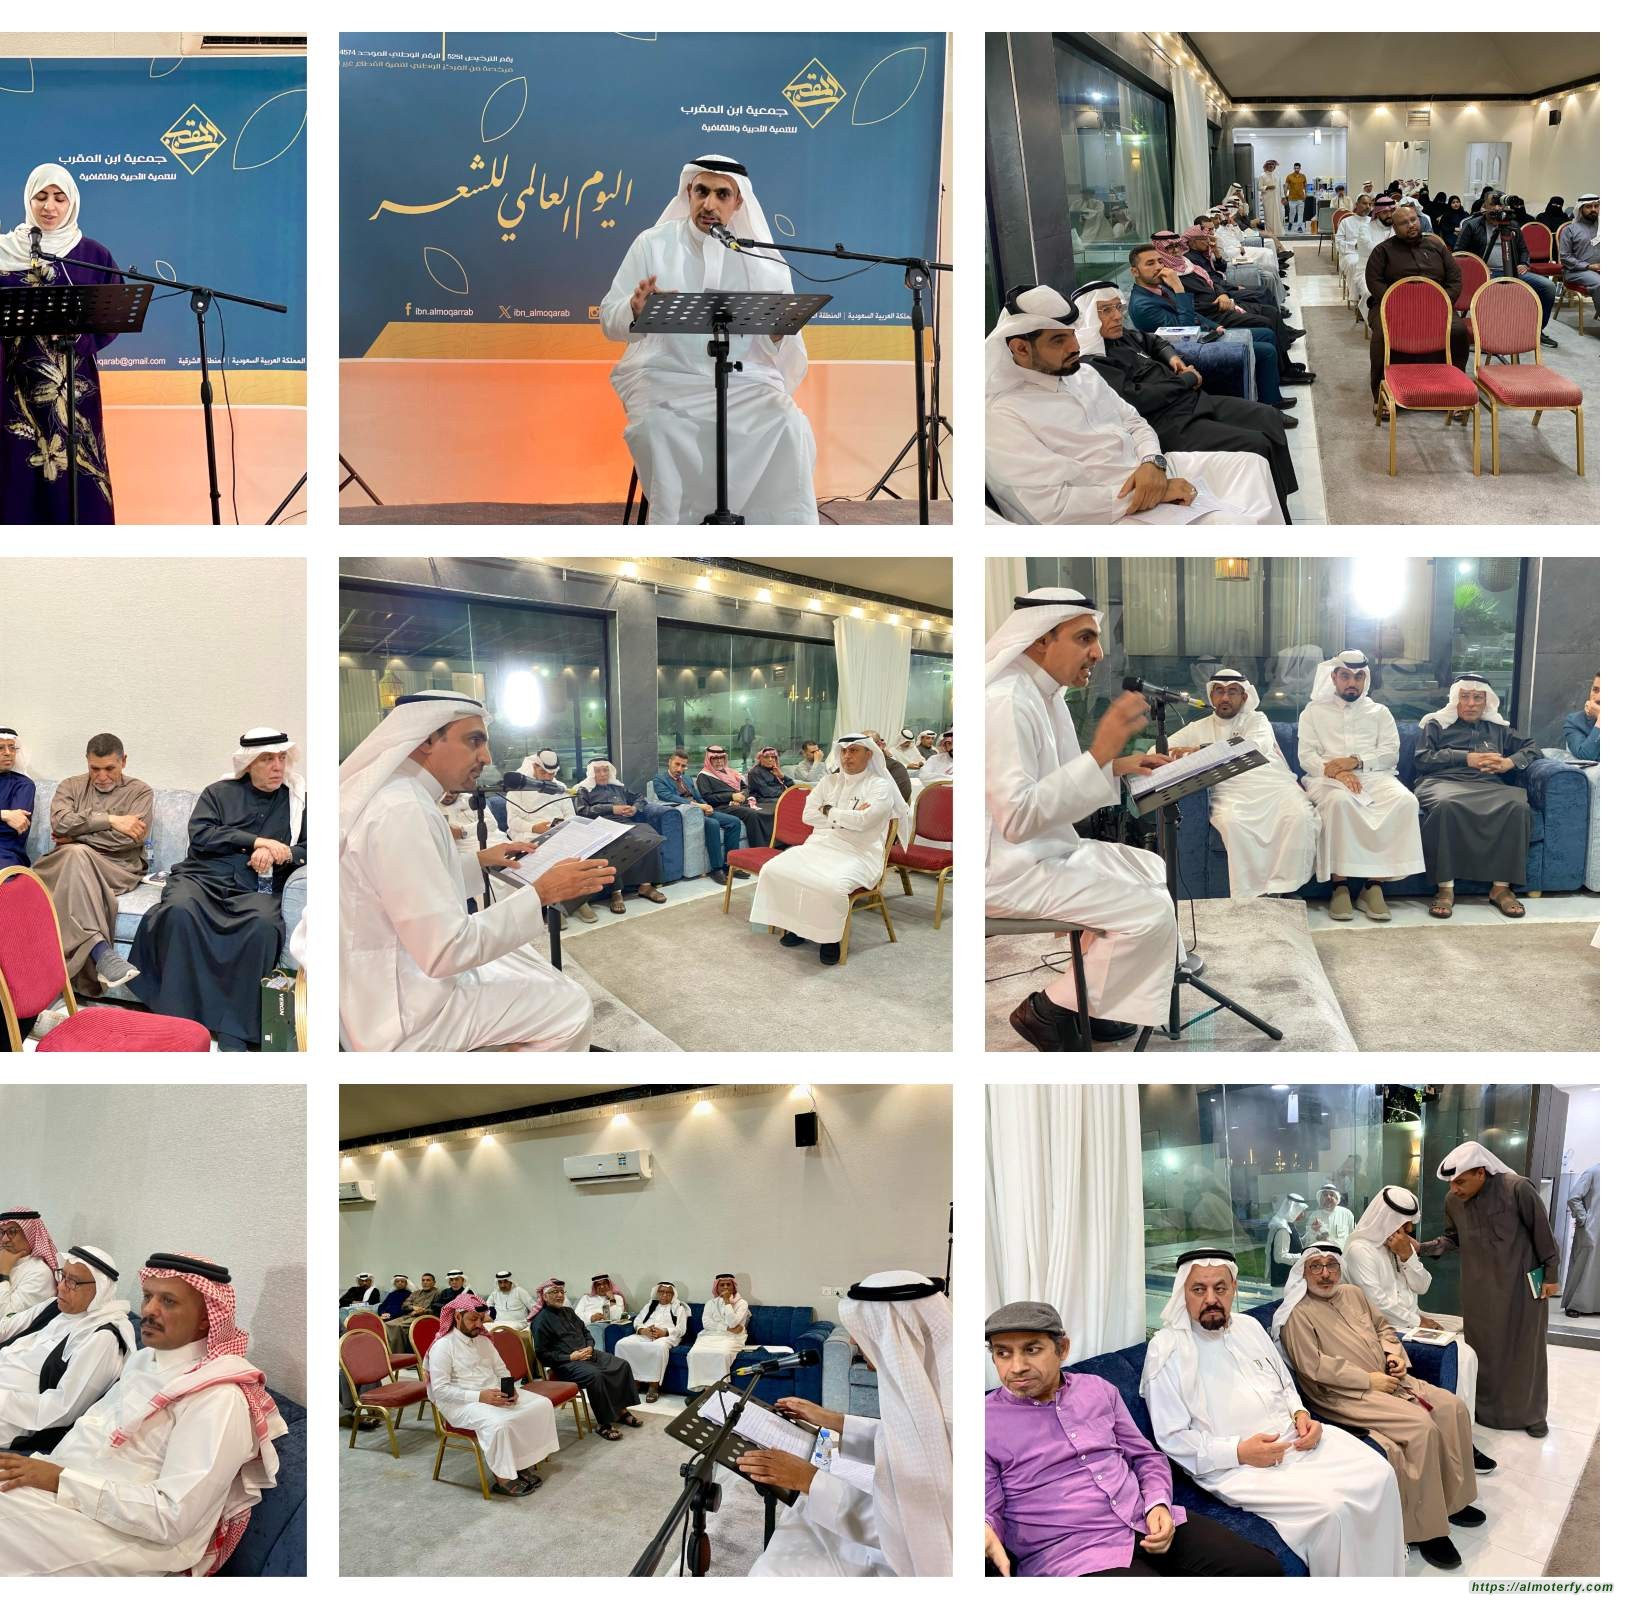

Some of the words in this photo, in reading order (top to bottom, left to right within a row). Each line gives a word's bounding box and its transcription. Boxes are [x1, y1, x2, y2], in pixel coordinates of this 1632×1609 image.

[680, 104, 723, 115] المقرب
[727, 105, 743, 116] ابن
[746, 106, 788, 117] جمعية
[701, 123, 740, 133] والثقافية
[769, 125, 798, 134] للتنمية
[58, 153, 102, 164] المقرب
[104, 154, 121, 165] ابن
[124, 153, 168, 165] جمعية
[79, 173, 118, 182] والثقافية
[148, 173, 177, 181] للتنمية
[368, 153, 508, 221] للشعر
[497, 162, 570, 242] العالمي
[575, 169, 633, 241] اليوم
[415, 307, 474, 317] ibn.almoqarrab
[513, 308, 570, 318] ibn_almoqarab
